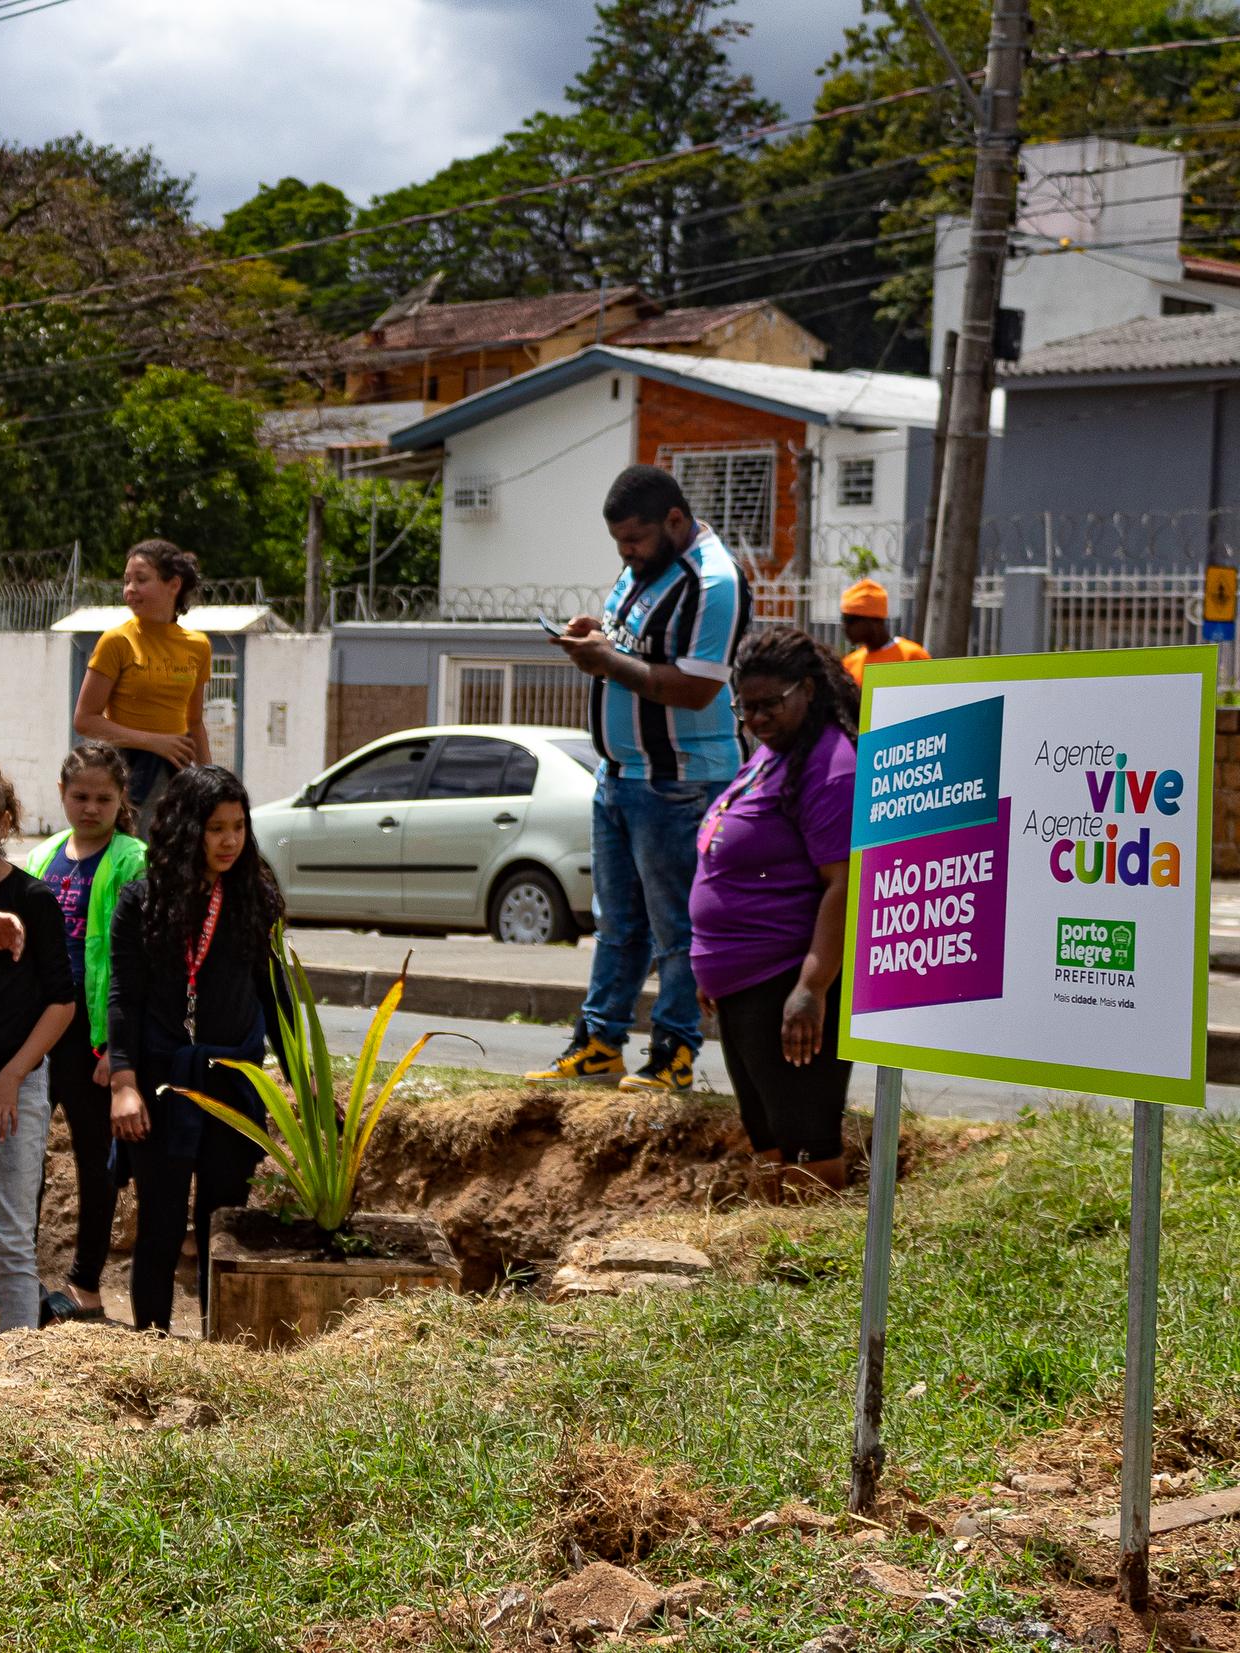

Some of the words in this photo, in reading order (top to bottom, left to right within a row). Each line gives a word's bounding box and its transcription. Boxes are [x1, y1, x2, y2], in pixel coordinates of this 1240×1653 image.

[873, 742, 915, 771] CUIDE
[916, 733, 947, 760] BEM
[1035, 740, 1050, 766] A
[1053, 740, 1115, 773] gente
[871, 774, 890, 798] DA
[892, 761, 943, 792] NOSSA
[1085, 752, 1184, 816] vive
[869, 778, 987, 823] #PORTOALEGRE.
[1023, 809, 1038, 835] A
[1041, 811, 1103, 843] gente
[1049, 823, 1181, 888] cuida
[873, 858, 921, 901] NÃO
[924, 850, 994, 892] DEIXE
[871, 902, 920, 938] LIXO
[923, 892, 976, 930] NOS
[1061, 923, 1108, 943] porto
[868, 931, 978, 976] PARQUES.
[1060, 940, 1112, 967] alegre
[1054, 968, 1136, 988] PREFEITURA
[1053, 993, 1070, 1003] Mais
[1099, 997, 1117, 1007] Mais
